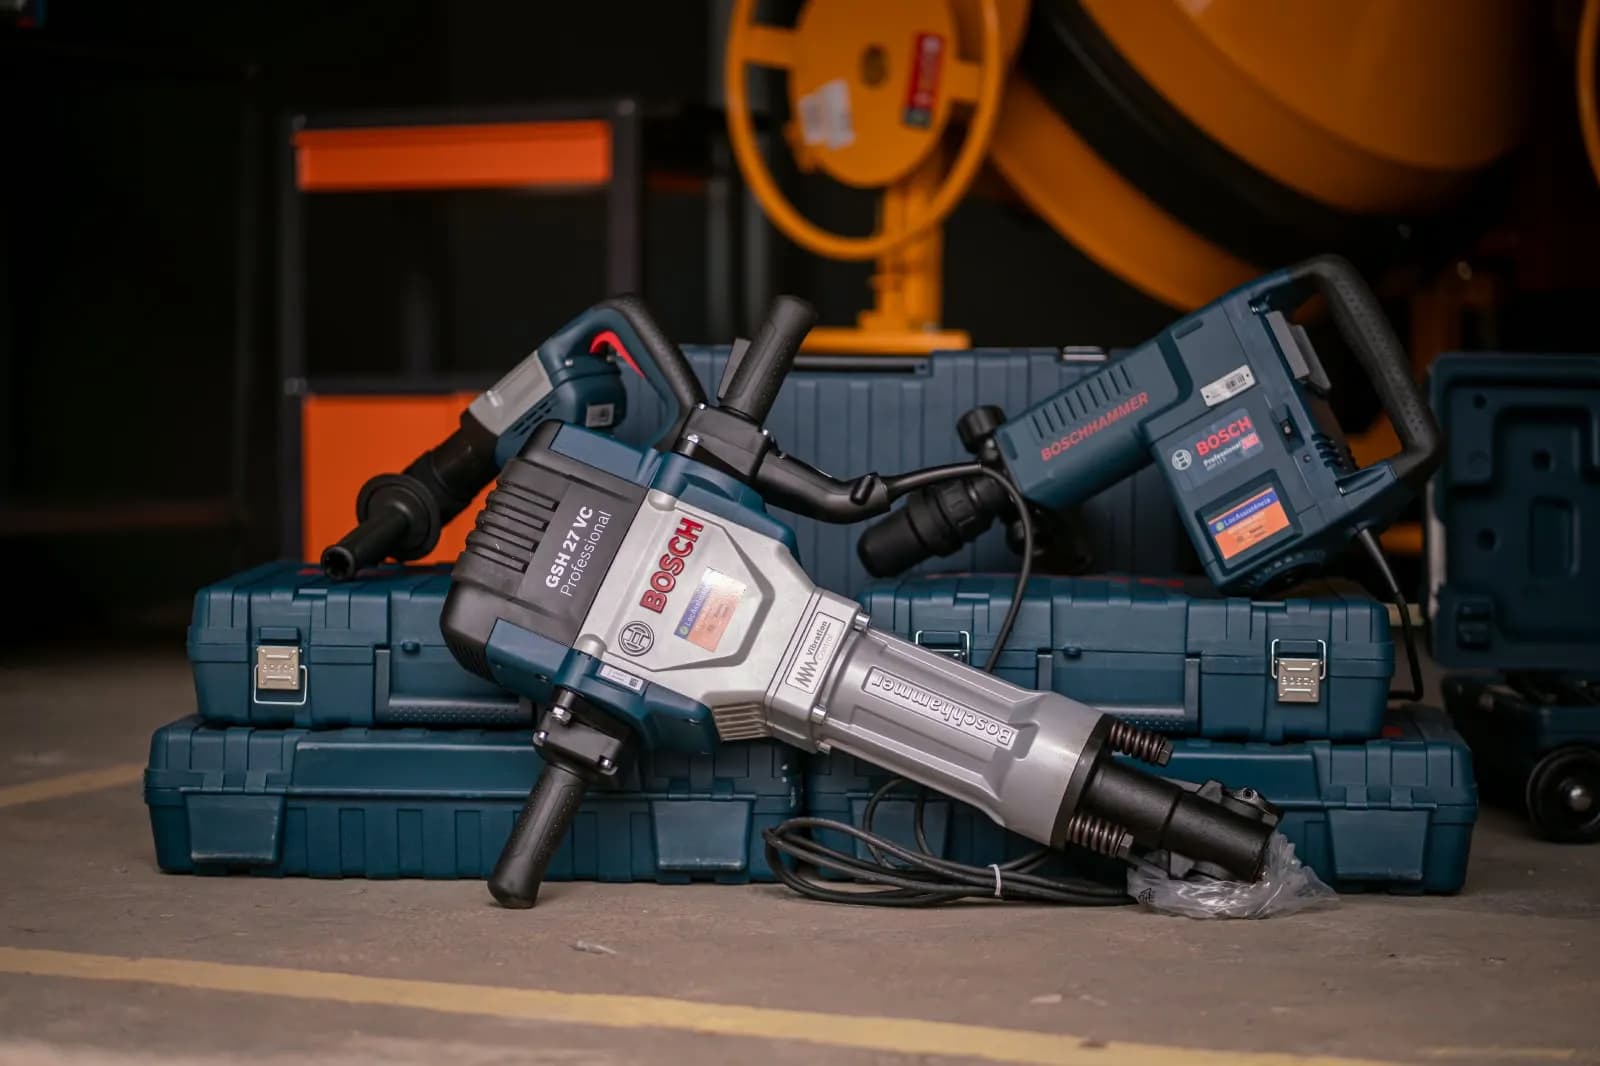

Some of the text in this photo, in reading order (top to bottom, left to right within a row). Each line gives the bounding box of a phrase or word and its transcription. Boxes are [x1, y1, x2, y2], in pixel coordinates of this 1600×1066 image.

[1040, 392, 1148, 462] BOSCHHAMMER
[1195, 416, 1253, 456] BOSCH
[545, 506, 593, 588] GSH 27 VC
[560, 510, 612, 597] Professional
[640, 517, 704, 614] BOSCH
[806, 621, 828, 656] Vibration
[871, 674, 1014, 746] Boschhammer
